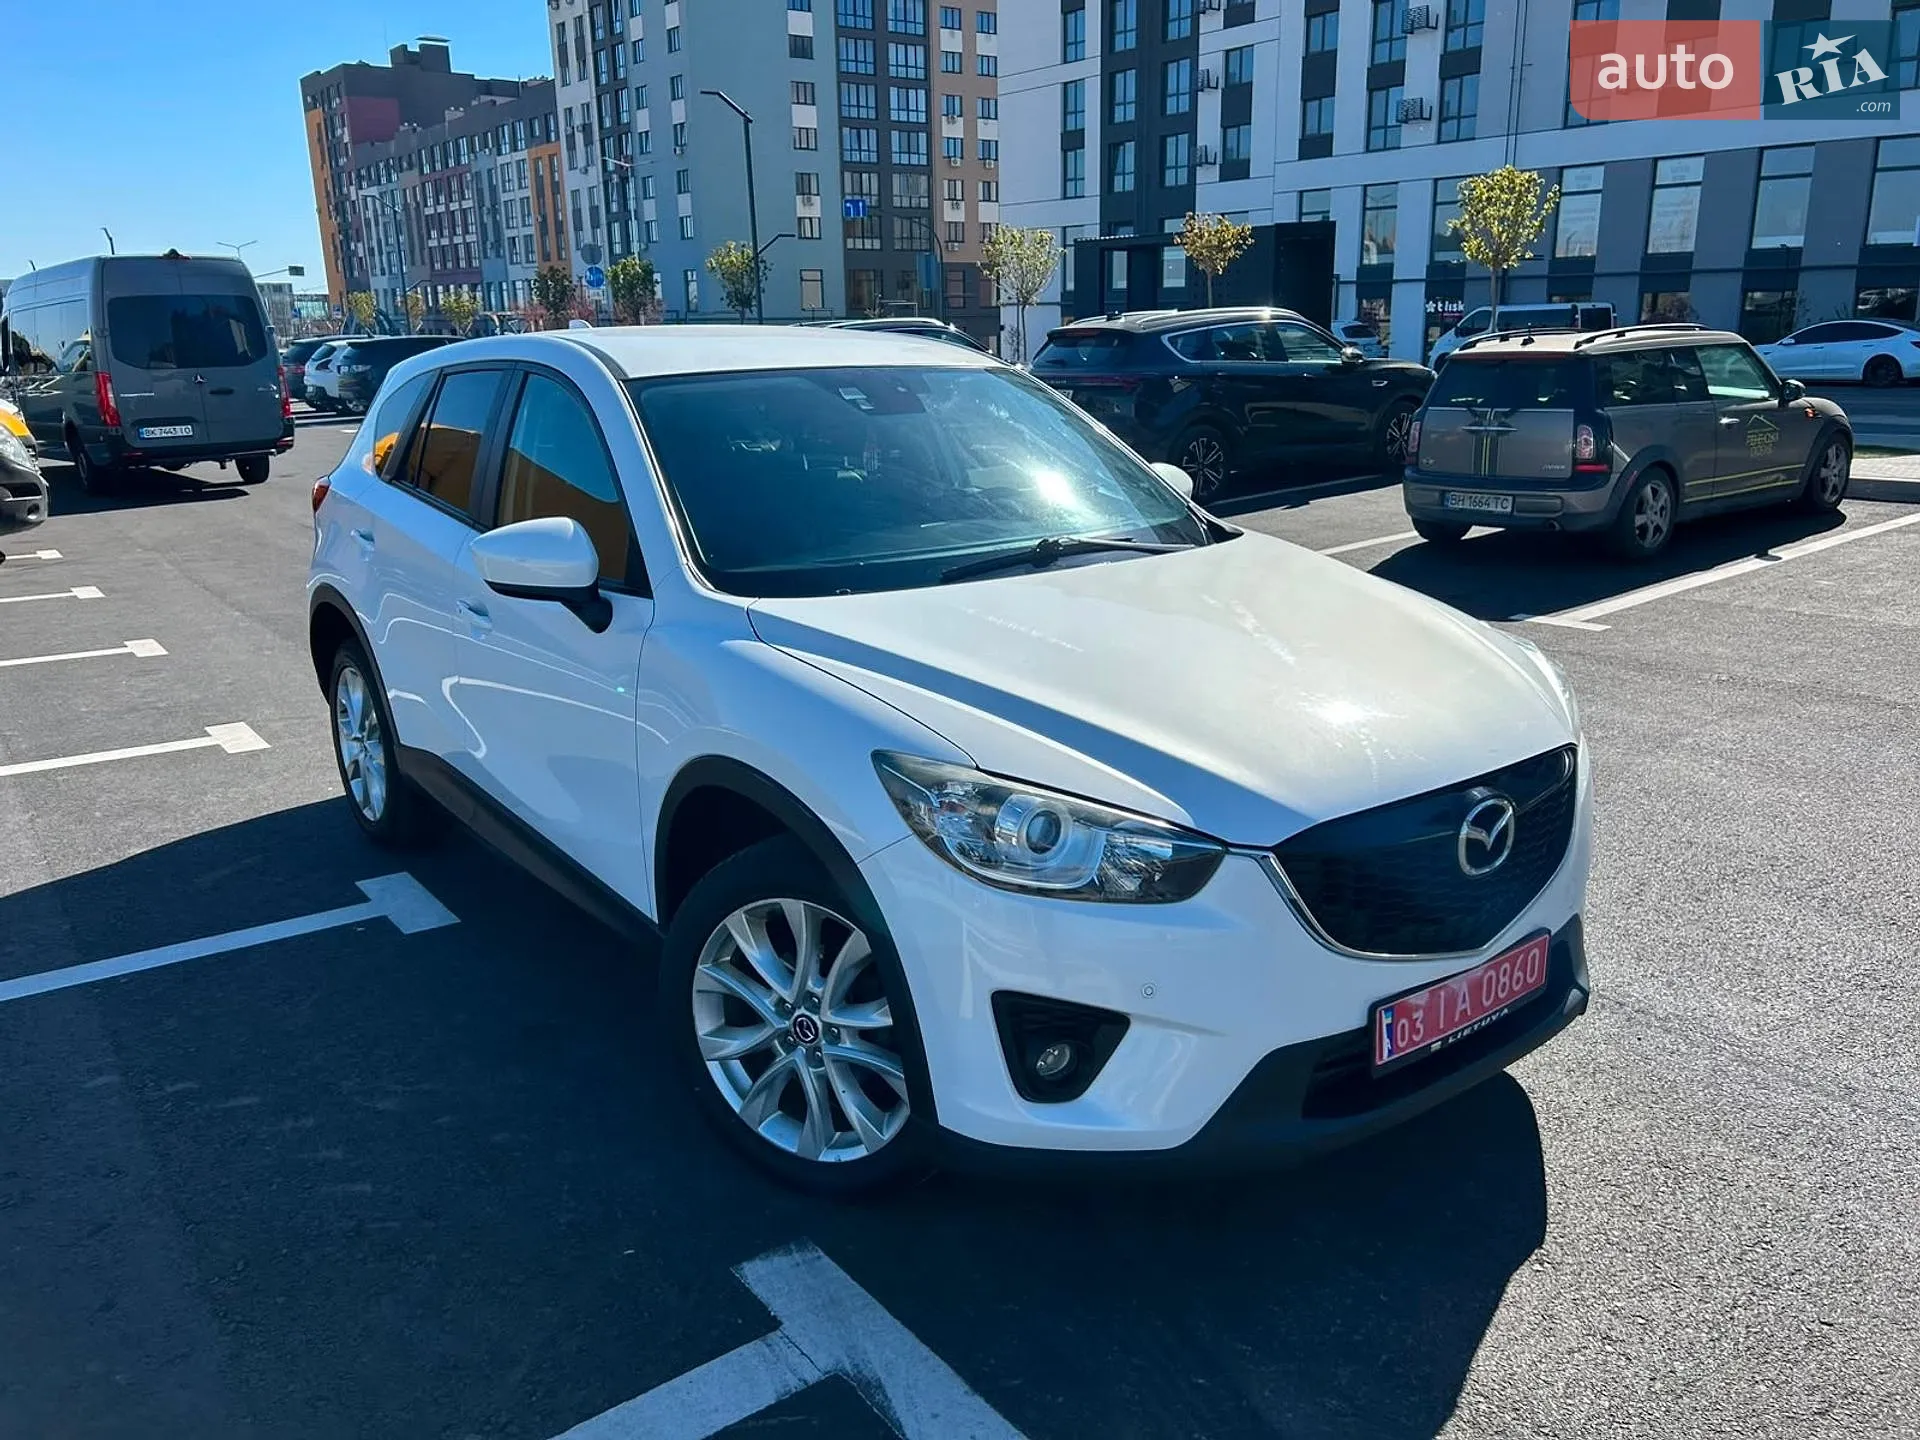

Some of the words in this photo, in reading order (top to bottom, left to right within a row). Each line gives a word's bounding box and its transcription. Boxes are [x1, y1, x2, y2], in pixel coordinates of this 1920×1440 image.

[1449, 493, 1465, 506] BH
[1468, 495, 1490, 509] 1664
[1494, 496, 1509, 510] TC
[1396, 1009, 1425, 1048] 03
[1481, 948, 1540, 1007] 0860
[1447, 1008, 1511, 1043] LIETUVA
